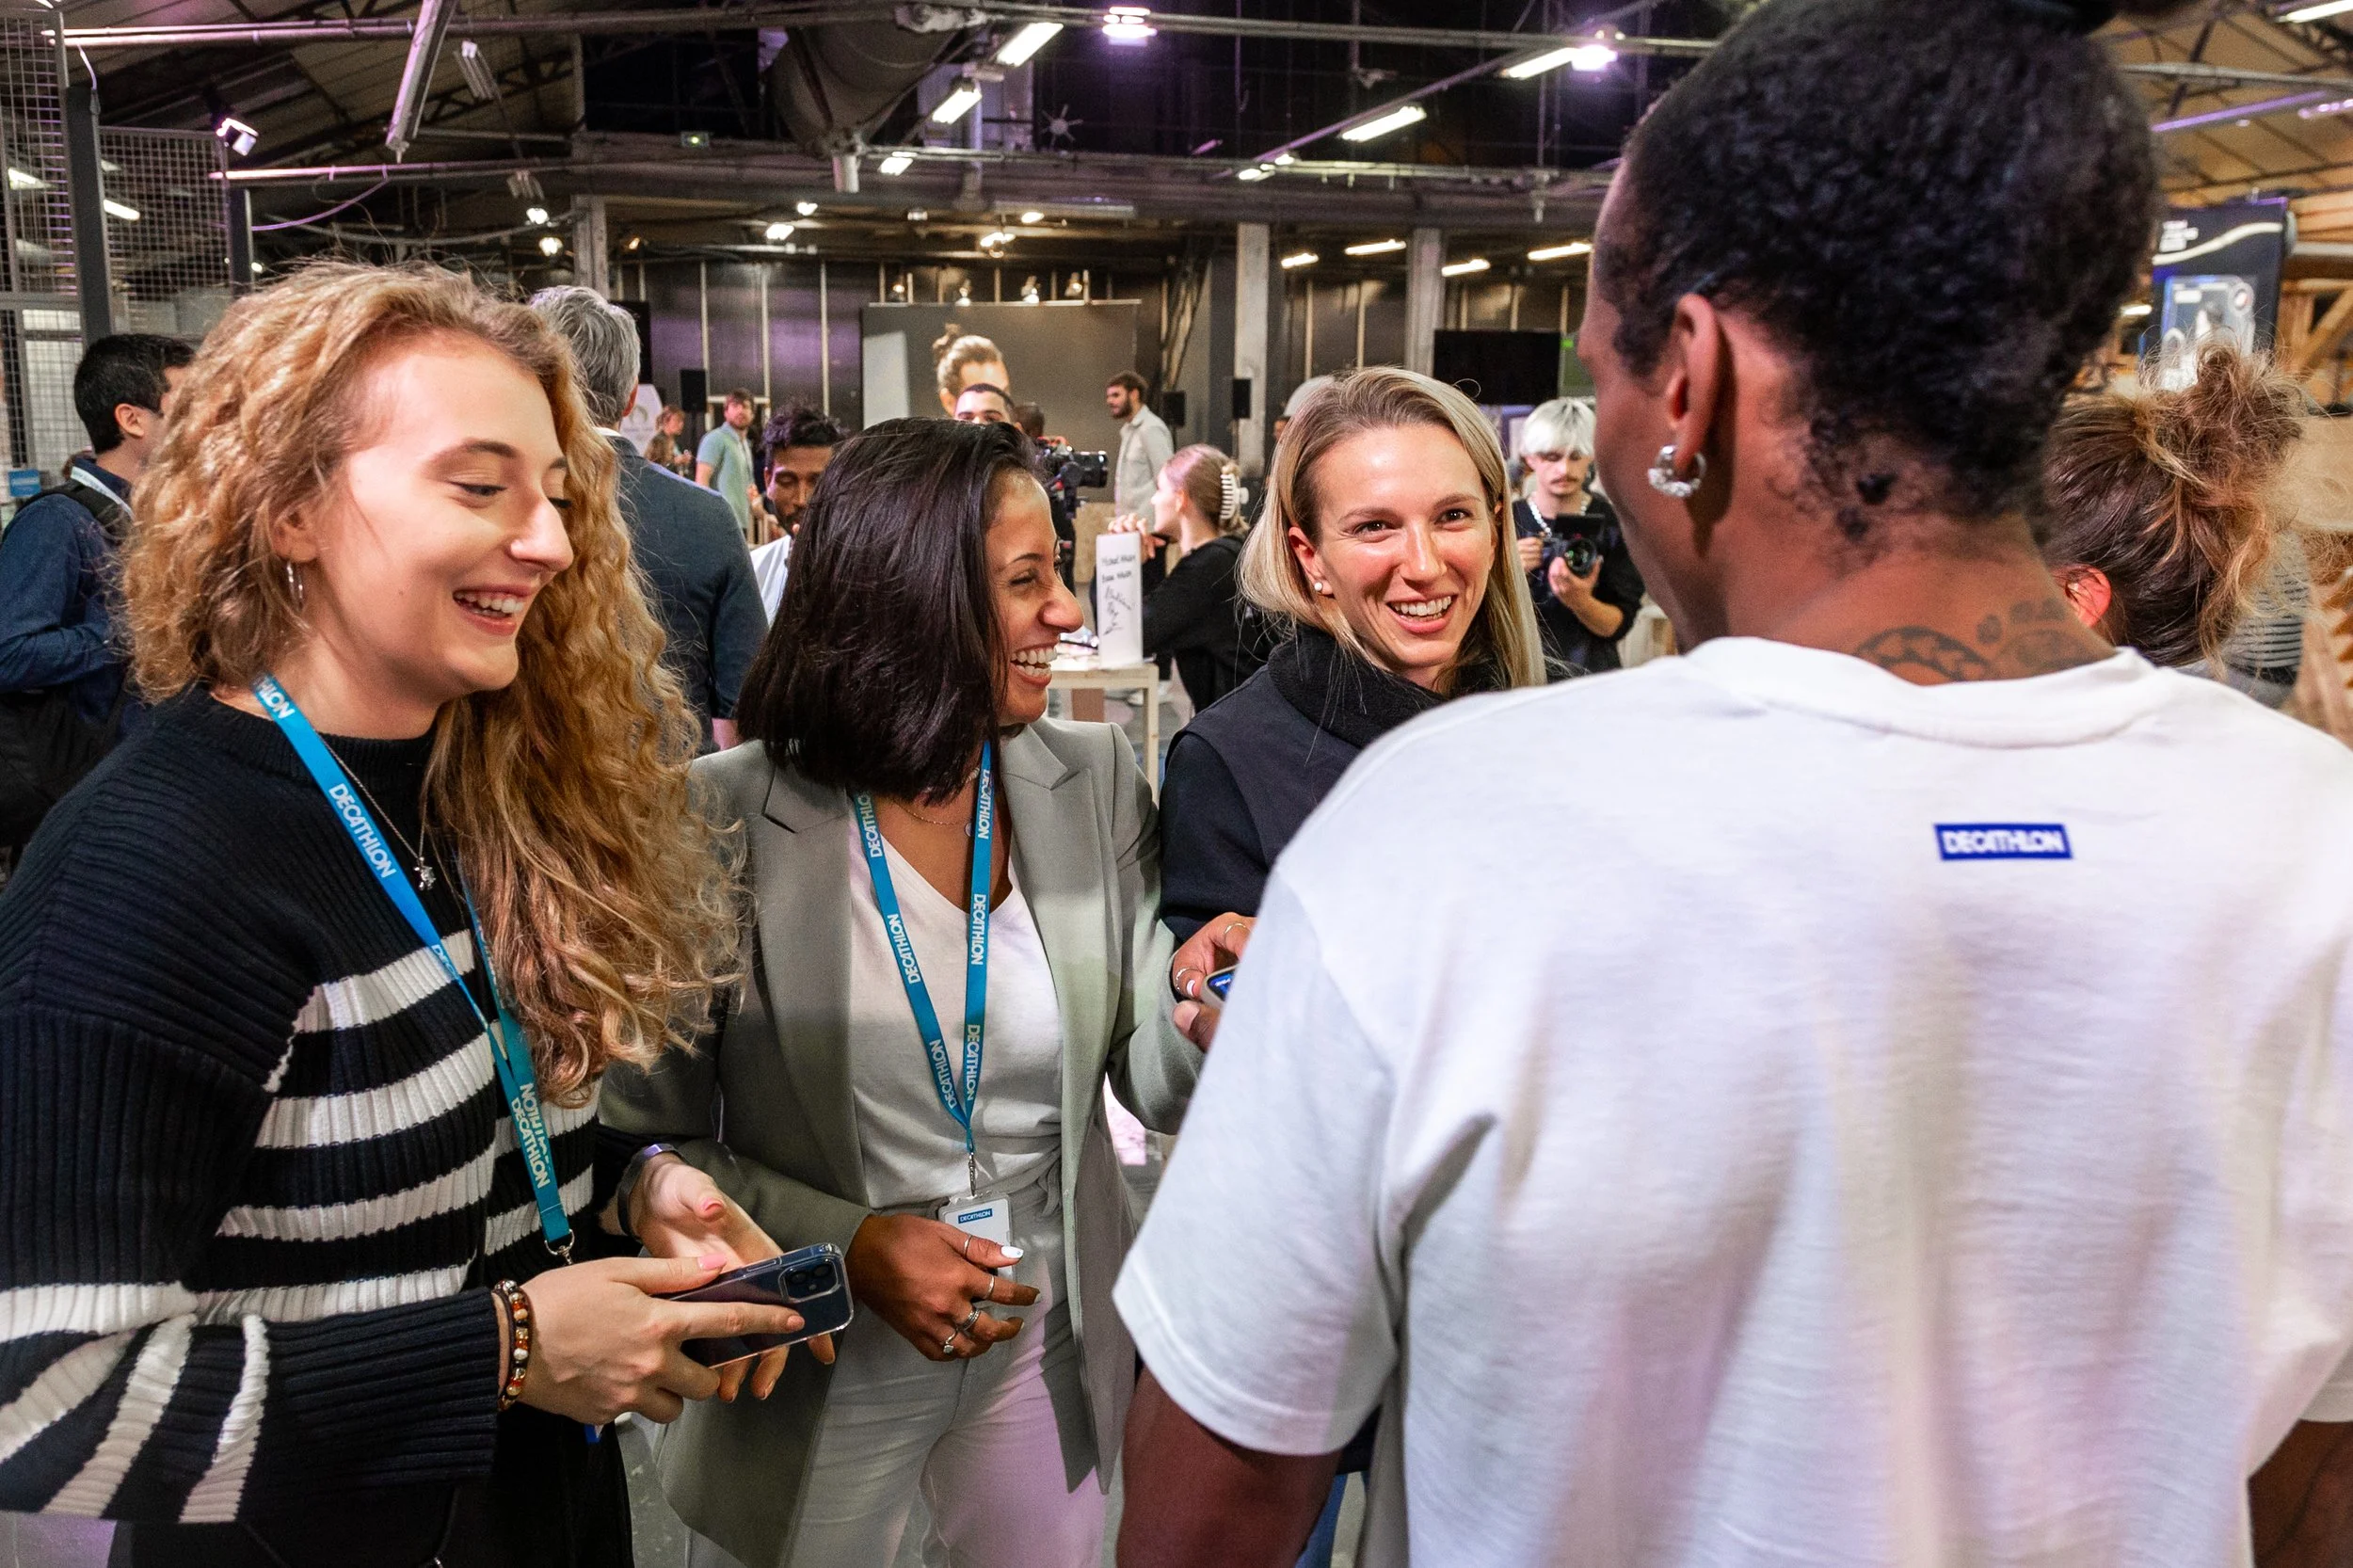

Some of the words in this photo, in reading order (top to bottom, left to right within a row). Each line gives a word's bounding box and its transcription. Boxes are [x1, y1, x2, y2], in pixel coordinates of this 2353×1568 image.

[328, 783, 397, 878] DECATHLON
[857, 792, 883, 858] DECATHLO
[1941, 829, 2066, 855] DECATHLON
[887, 914, 921, 984] DECATHLON
[970, 893, 986, 966] DECATHLON
[929, 1040, 958, 1110] DECATHLON
[966, 1024, 981, 1101] DECATHLON
[511, 1097, 552, 1190] DECATHLON
[959, 1209, 992, 1223] DECATHLON
